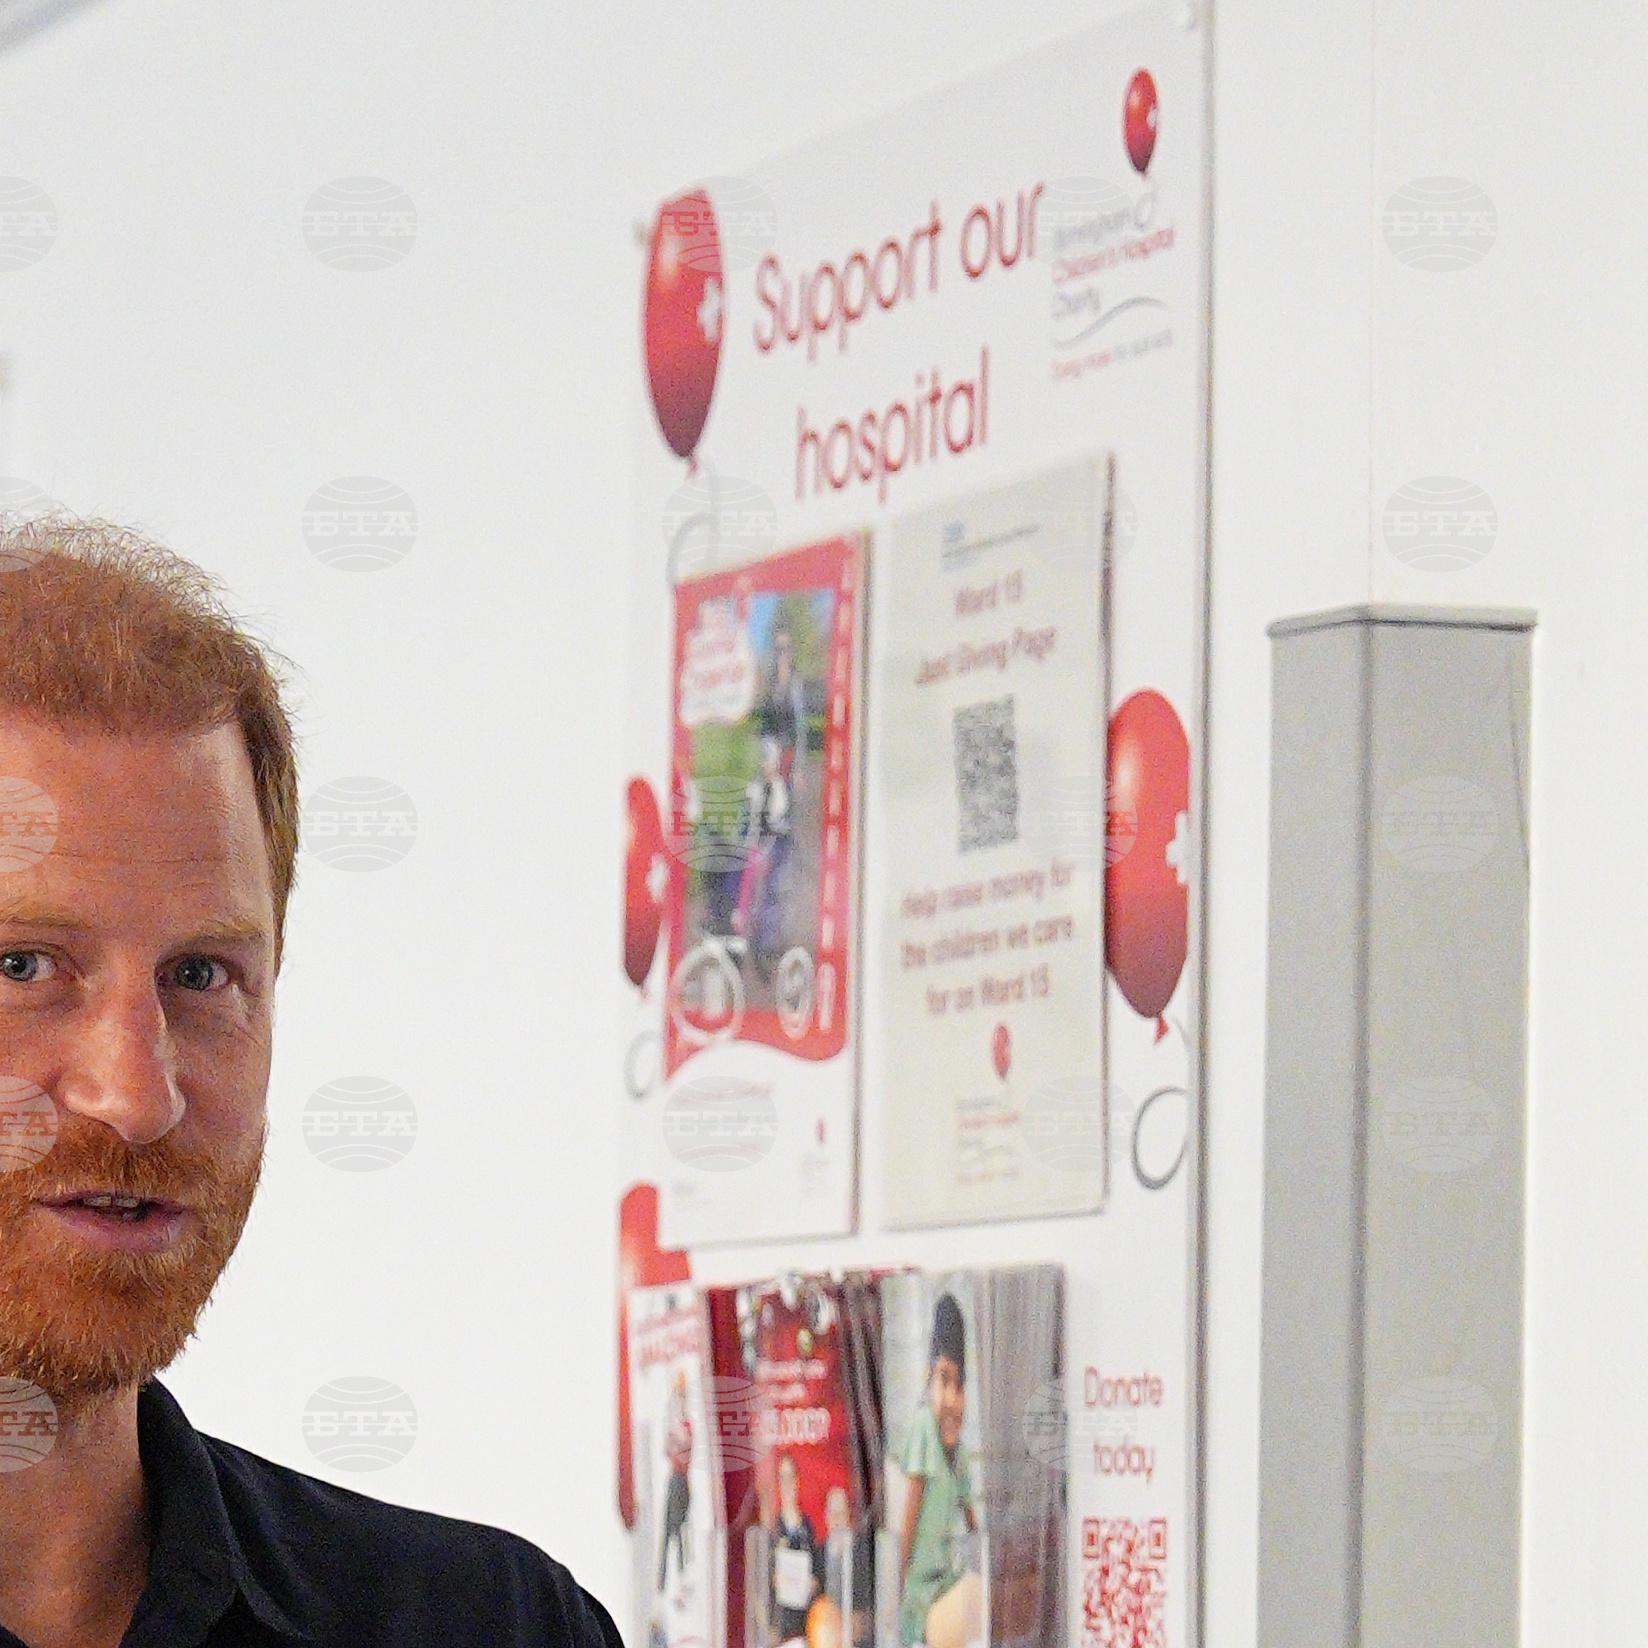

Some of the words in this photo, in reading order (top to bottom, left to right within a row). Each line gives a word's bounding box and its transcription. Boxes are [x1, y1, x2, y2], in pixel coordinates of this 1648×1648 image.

[753, 197, 942, 362] Support
[960, 184, 1045, 279] our
[794, 344, 990, 505] hospital
[981, 974, 1025, 1005] Ward
[1084, 1364, 1163, 1408] Donate
[1093, 1436, 1156, 1485] today
